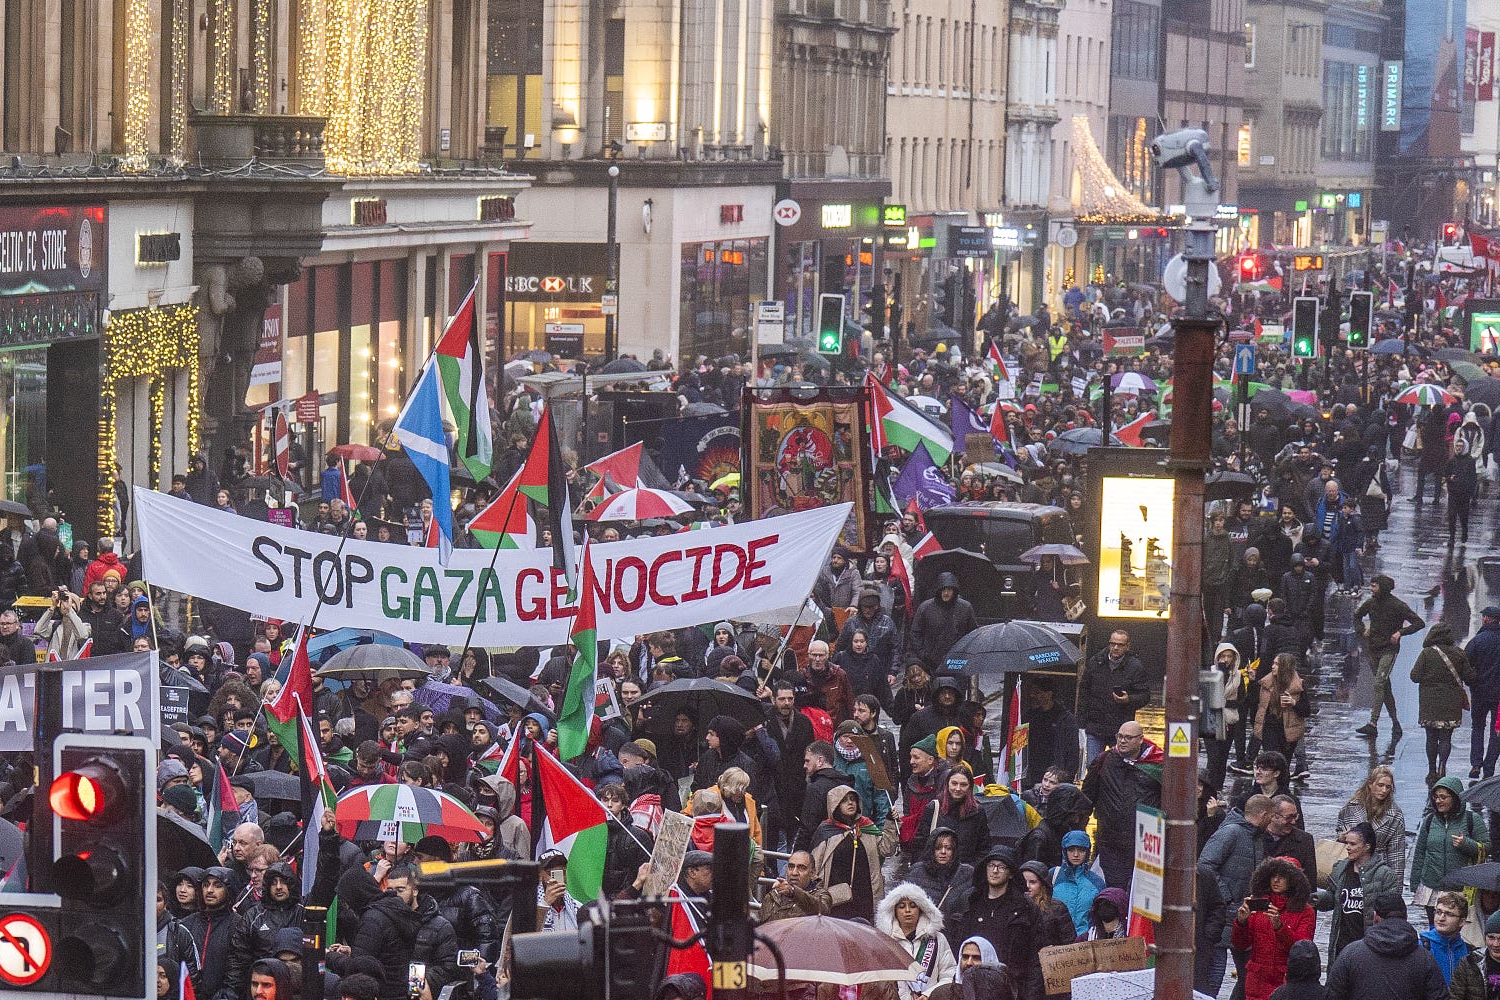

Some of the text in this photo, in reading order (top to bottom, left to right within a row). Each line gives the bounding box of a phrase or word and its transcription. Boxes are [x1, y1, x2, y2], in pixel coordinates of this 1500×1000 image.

[1385, 65, 1399, 125] PRIMARK
[26, 231, 37, 272] FC
[42, 229, 67, 271] STORE
[251, 534, 780, 626] STOP GAZA GENOCIDE
[160, 706, 187, 714] EASEFIRE
[1143, 832, 1162, 856] CCTV
[716, 963, 744, 989] 13
